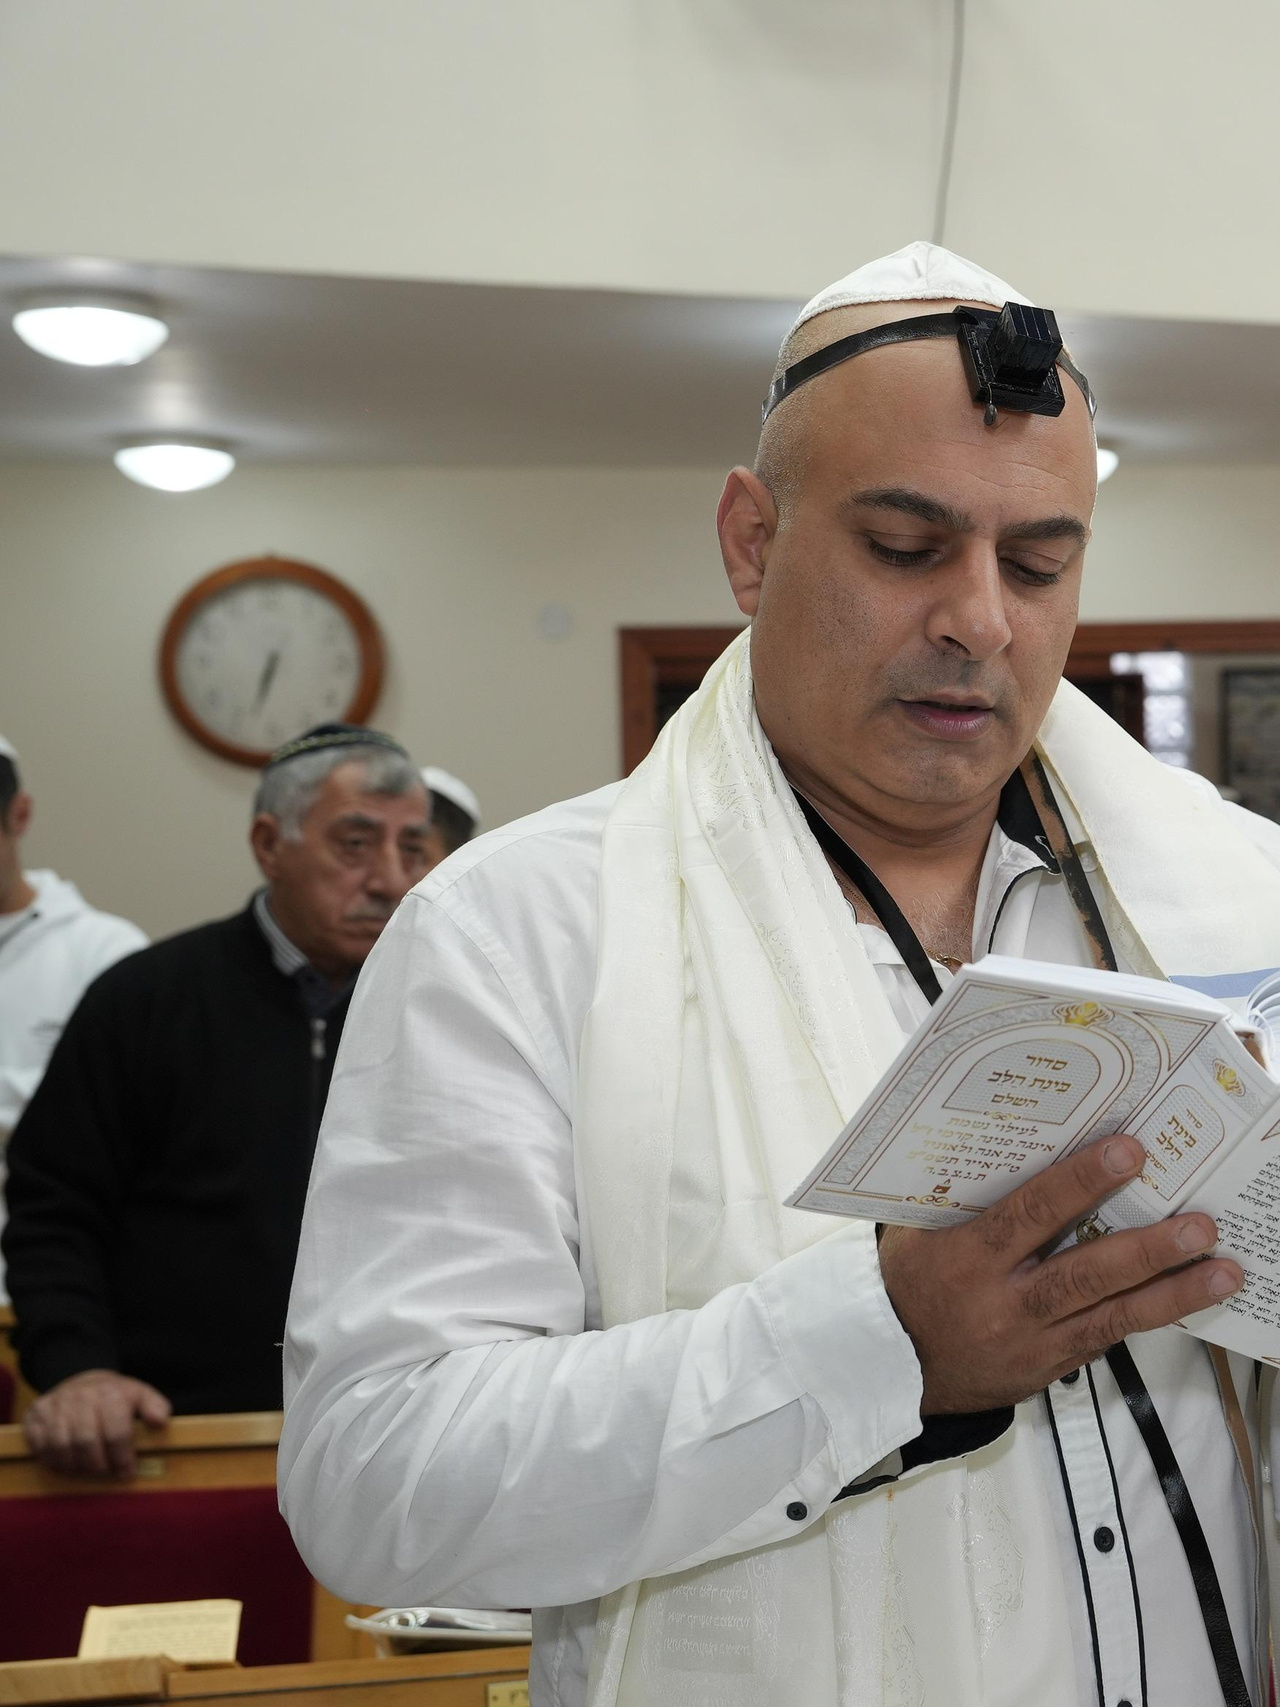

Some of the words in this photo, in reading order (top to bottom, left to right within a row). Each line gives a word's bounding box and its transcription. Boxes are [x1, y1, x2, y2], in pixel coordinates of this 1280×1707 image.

[1026, 1055, 1068, 1071] סדור
[991, 1093, 1039, 1109] השלם
[946, 1117, 991, 1130] נשמת
[995, 1123, 1039, 1136] לעילוי
[1016, 1139, 1056, 1152] אינגה
[975, 1147, 1002, 1158] אנה
[1004, 1152, 1027, 1162] בת
[964, 1159, 993, 1170] אייר
